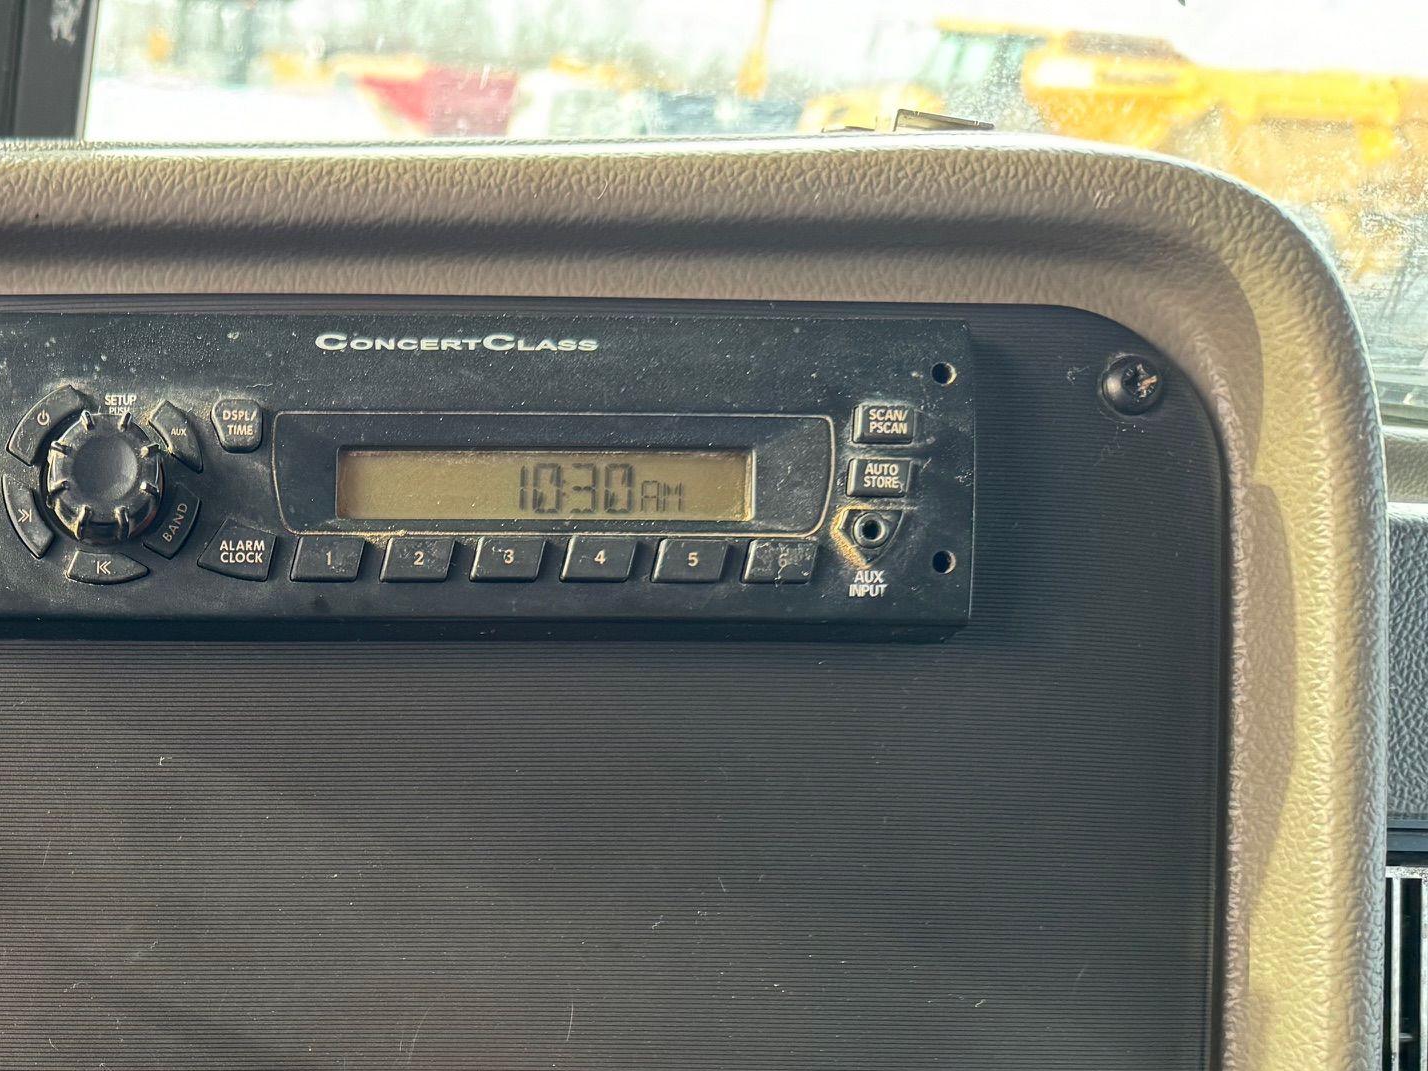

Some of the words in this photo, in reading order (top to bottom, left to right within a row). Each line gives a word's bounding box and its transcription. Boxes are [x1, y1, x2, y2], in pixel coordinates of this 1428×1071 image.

[105, 393, 137, 406] SETUP
[869, 408, 907, 422] SCAN/
[171, 427, 187, 437] AUX
[227, 423, 254, 436] TIME
[869, 421, 907, 435] PSCAN
[864, 463, 899, 476] AUTO
[863, 475, 899, 489] STORE
[162, 502, 188, 542] BAND
[219, 539, 265, 552] ALARM
[220, 551, 264, 564] CLOCK
[325, 552, 333, 566] 1
[413, 551, 425, 566] 2
[504, 550, 515, 564] 3
[594, 551, 606, 564] 4
[687, 552, 699, 567] 5
[854, 570, 885, 584] AUX
[849, 583, 889, 597] INPUT
